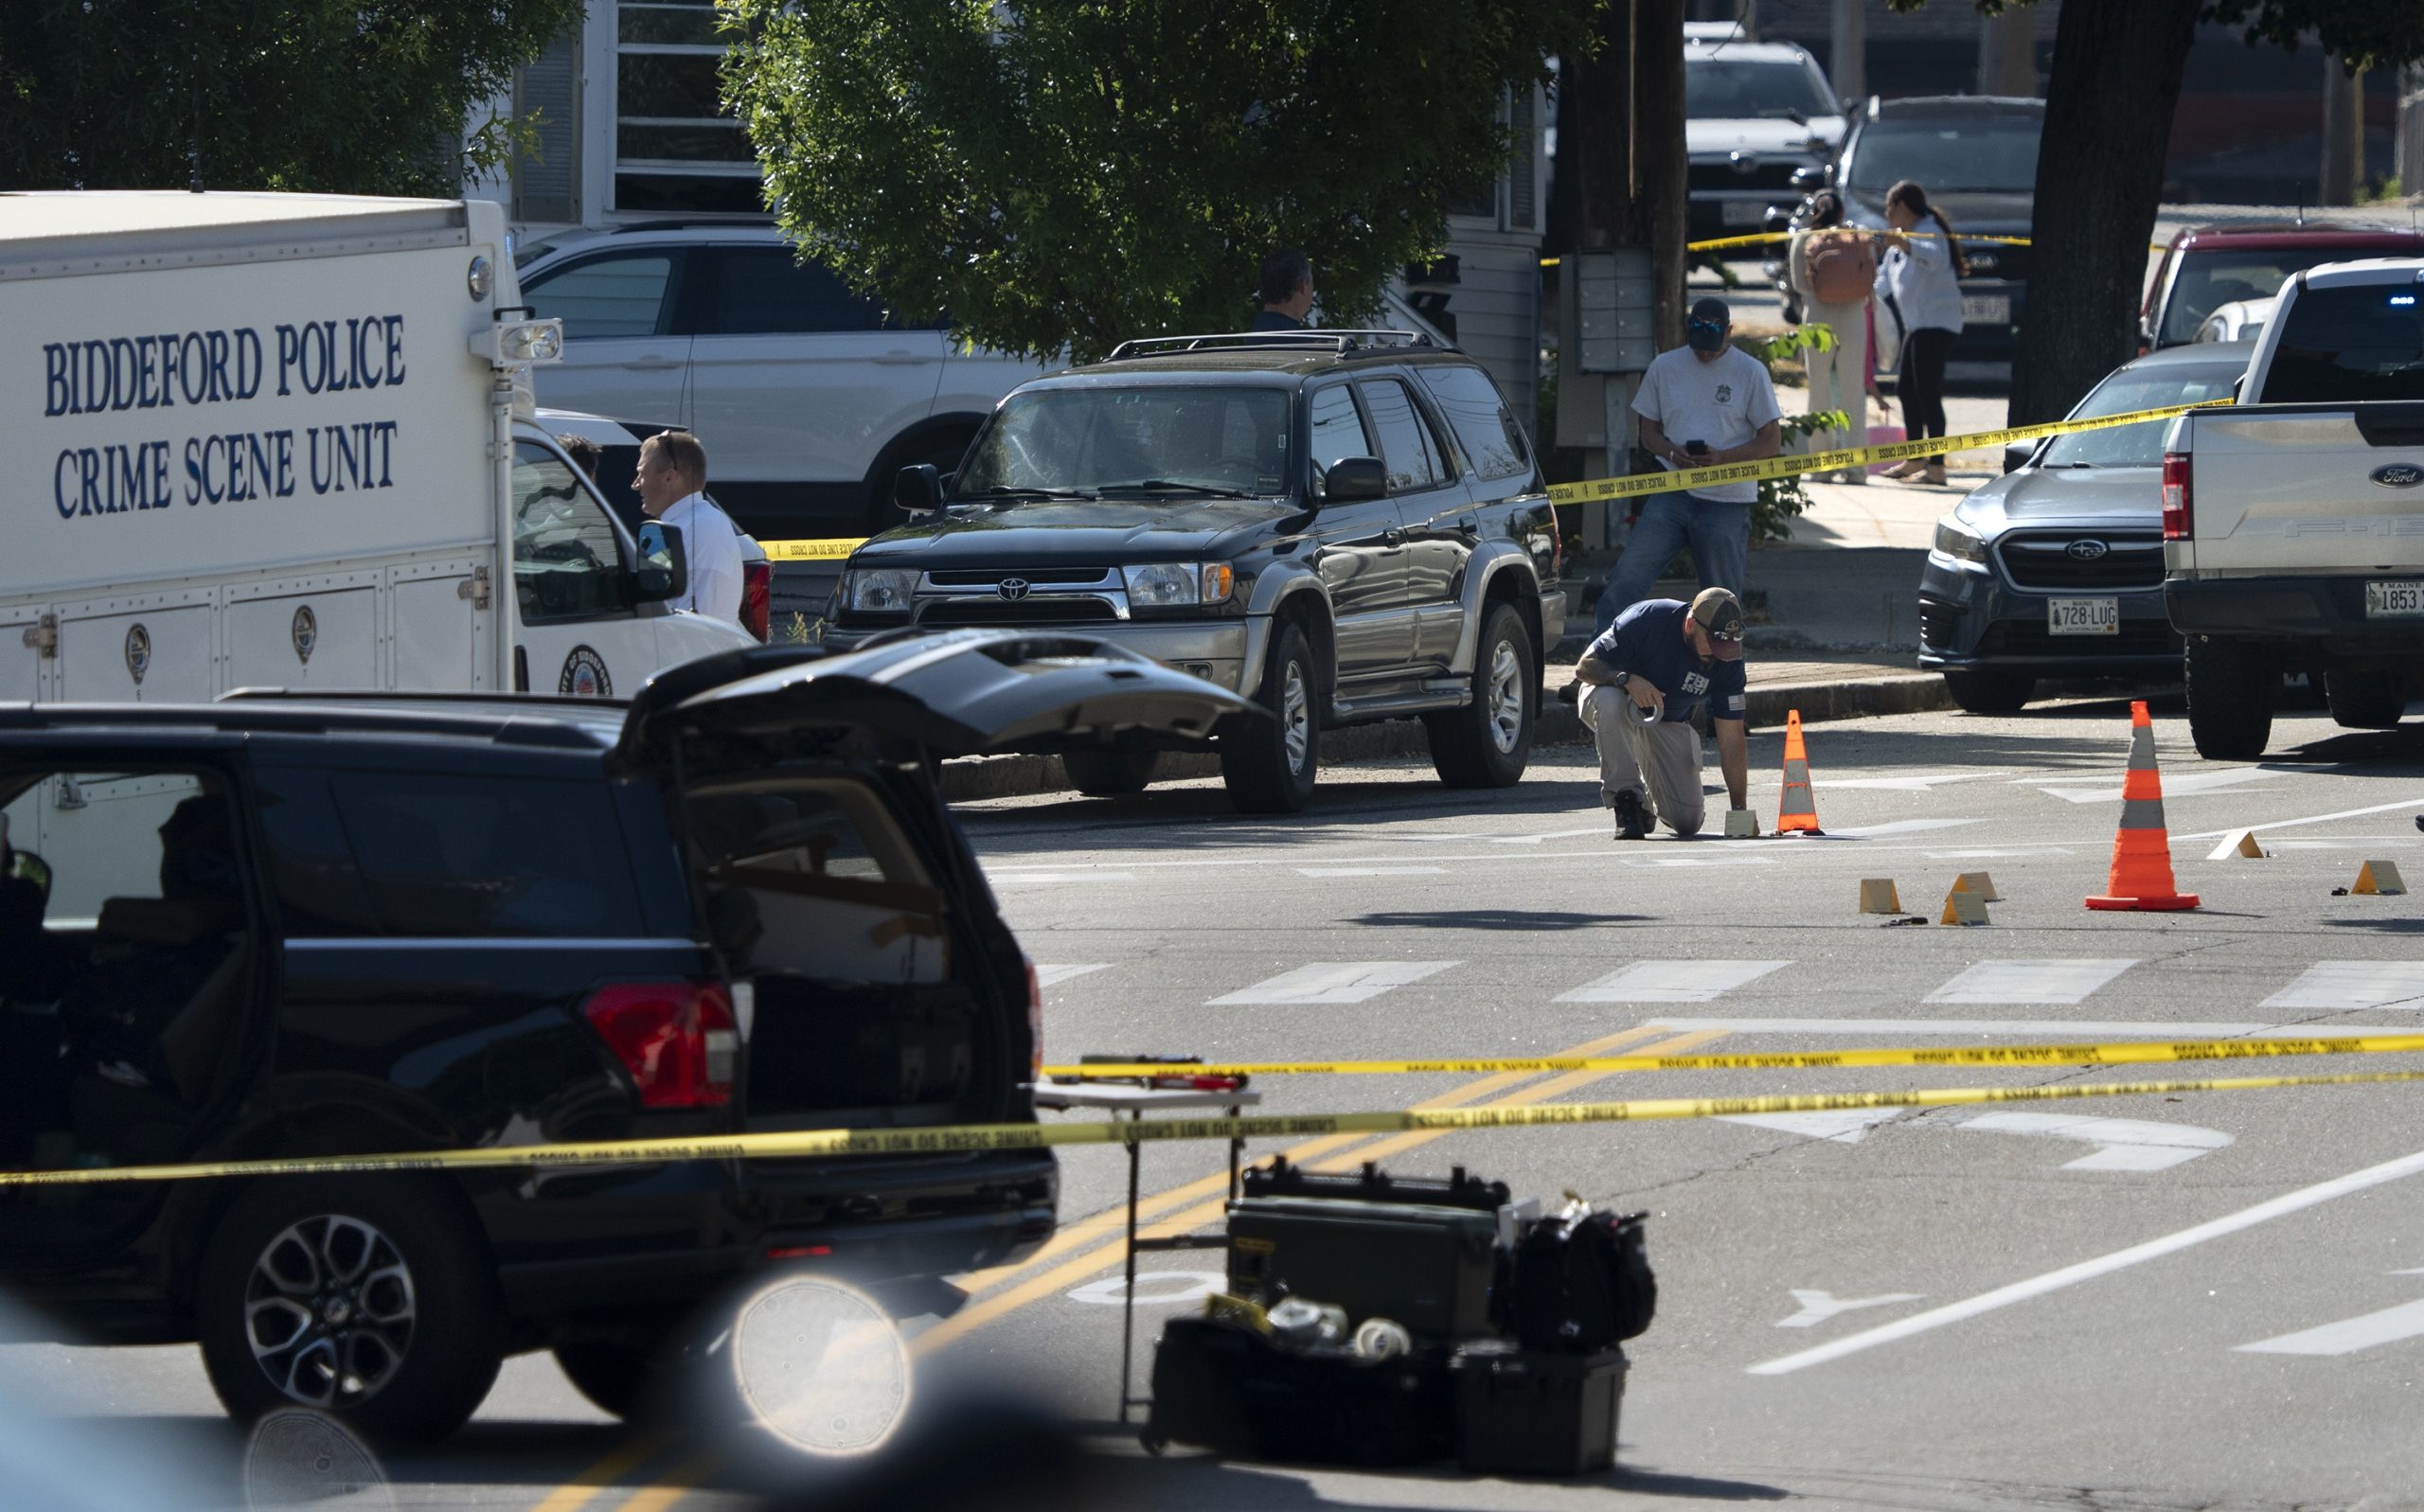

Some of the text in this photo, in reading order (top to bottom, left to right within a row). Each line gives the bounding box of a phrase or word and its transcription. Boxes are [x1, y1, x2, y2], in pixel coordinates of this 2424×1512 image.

[43, 314, 405, 417] BIDDEFORD POLICE
[1990, 434, 2002, 444] NOT
[2011, 430, 2023, 440] LINE
[1879, 439, 1949, 458] POLICE LINE DO NOT CROSS
[55, 420, 398, 519] CRIME SCENE UNIT
[1784, 453, 1854, 471] POLICE LINE DO NOT CROSS
[1690, 465, 1759, 484] POLICE LINE DO NOT CROSS
[2383, 469, 2416, 483] Ford
[1598, 476, 1666, 494] POLICE LINE DO NOT CROSS
[1557, 488, 1574, 500] POLICE
[2382, 590, 2416, 611] 1853
[1684, 671, 1710, 690] FBI
[1472, 1111, 1499, 1126] NOT
[1506, 1110, 1524, 1125] DO
[1531, 1108, 1577, 1123] SCENE
[1582, 1104, 1628, 1120] CRIME
[1180, 1123, 1207, 1138] NOT
[1213, 1122, 1230, 1137] DO
[1239, 1120, 1283, 1136] SCENE
[1290, 1119, 1337, 1134] CRIME
[884, 1134, 913, 1150] NOT
[916, 1134, 937, 1149] DO
[947, 1132, 990, 1147] SCENE
[995, 1130, 1041, 1146] CRIME
